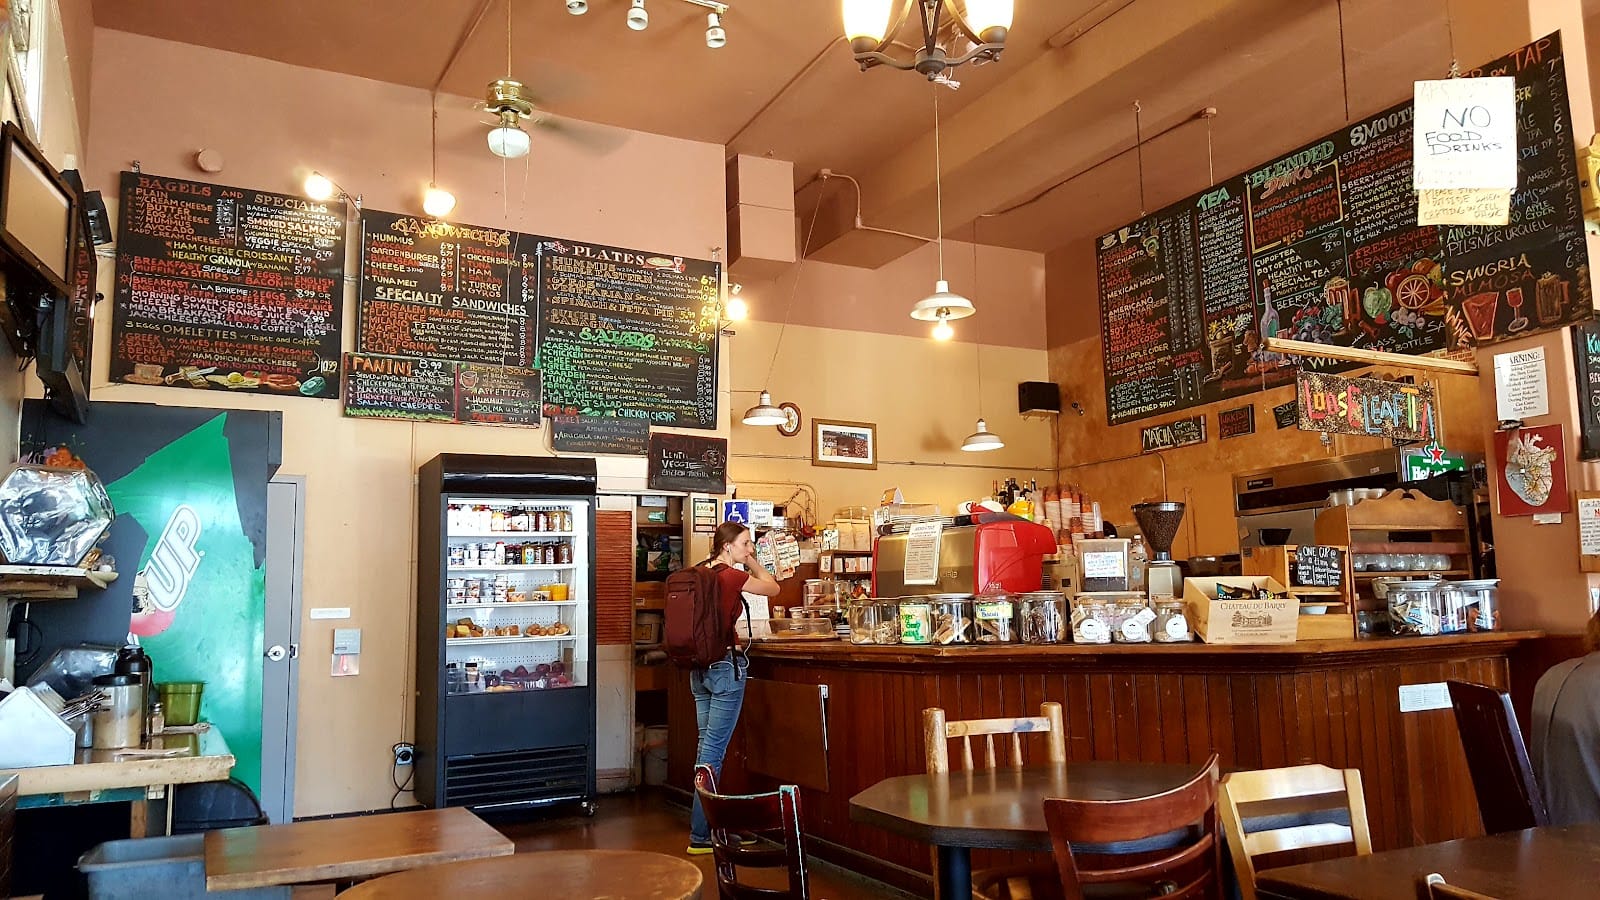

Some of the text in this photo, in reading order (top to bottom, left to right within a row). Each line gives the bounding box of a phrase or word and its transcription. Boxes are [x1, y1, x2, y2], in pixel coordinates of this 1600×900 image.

[1509, 39, 1551, 72] TAP
[1515, 85, 1532, 103] GER
[1443, 105, 1491, 129] NO
[1426, 130, 1482, 144] FOOD
[1428, 143, 1502, 156] DRINKS
[1250, 140, 1334, 189] BLENDED
[1347, 173, 1375, 189] BERRY
[136, 187, 168, 199] PLAIN
[139, 177, 328, 213] BAGELS AND SPECIALS
[1197, 187, 1230, 211] TEA
[1509, 188, 1539, 208] DAMS
[147, 203, 191, 216] BUTTER
[180, 201, 213, 211] CHEESE
[1351, 196, 1400, 218] CRANBERRY
[1355, 201, 1406, 226] LEMONADE
[146, 216, 191, 228] HUMMUS
[246, 216, 336, 235] SMOKED SALMON
[1353, 208, 1414, 236] BANANA SHAKE
[245, 237, 279, 246] VEGGIE
[372, 233, 414, 245] HUMMUS
[1399, 226, 1437, 245] SQUEE
[1446, 230, 1503, 257] PILSNER
[172, 250, 208, 262] HEALTHY
[173, 240, 295, 264] HAM CHEESE CROISSANT
[371, 246, 439, 263] GARDENBURGER
[466, 253, 495, 264] CHICKEN
[572, 245, 645, 266] PLATES
[1355, 251, 1400, 268] ORANGE
[133, 255, 200, 270] BREAKFAST
[256, 271, 282, 280] EGGS
[294, 275, 335, 287] ENGLISH
[371, 262, 492, 276] CHEESE HAM
[551, 255, 616, 272] HUMMUS
[1267, 259, 1321, 281] HEALTHY TEA
[1450, 253, 1532, 286] SANGRIA
[191, 270, 330, 292] STRIPS BACON COFFEE
[551, 263, 594, 276] MIDDLE
[595, 269, 653, 284] EASTERN
[1270, 266, 1330, 292] SPECIAL TEA
[132, 276, 189, 289] BREAKFAST
[371, 275, 502, 291] TUNA MELT TURKEY
[1107, 272, 1165, 299] MEXICAN MOCHA
[1453, 270, 1535, 299] MIMOSA
[375, 286, 526, 315] SPECIALTY SANDWICHES
[467, 287, 501, 298] GYROS
[551, 283, 634, 301] VEGETARIAN
[131, 290, 180, 302] MORNING
[309, 310, 330, 318] AND
[182, 301, 292, 320] SMALL ORANGE JUICE
[370, 300, 427, 315] JERUSALEM
[551, 296, 675, 318] SPINACH FETA PIE
[1108, 296, 1154, 315] AMERICANO
[1276, 294, 1302, 311] BEER
[128, 310, 296, 334] JACK COFFEE
[369, 308, 427, 322] FLORENCE
[369, 316, 409, 327] MILANO
[550, 308, 597, 320] QUICHE
[550, 314, 615, 330] LASAGNA
[126, 332, 160, 341] GREEK
[162, 324, 237, 340] OMELETTES
[292, 337, 321, 346] Coffee
[367, 331, 412, 341] ATHENS
[369, 322, 410, 334] NAPOLI
[126, 339, 164, 349] SALSA
[367, 336, 437, 352] CALIFORNIA
[1140, 331, 1166, 343] COCOA
[127, 348, 175, 358] DENVER
[367, 343, 397, 354] CLUB
[545, 342, 581, 353] CAESAR
[547, 348, 584, 359] CHICKEN
[128, 354, 168, 363] VEGGIE
[352, 356, 412, 377] PANINI
[547, 355, 571, 365] CHEF
[547, 369, 586, 379] GARDEN
[547, 375, 573, 384] TUNA
[357, 398, 393, 408] SALAMI
[548, 394, 622, 409] THE LAST SALAD
[563, 389, 604, 400] BOHEME
[1304, 379, 1405, 433] LOOSE LEAF
[145, 504, 203, 613] UP
